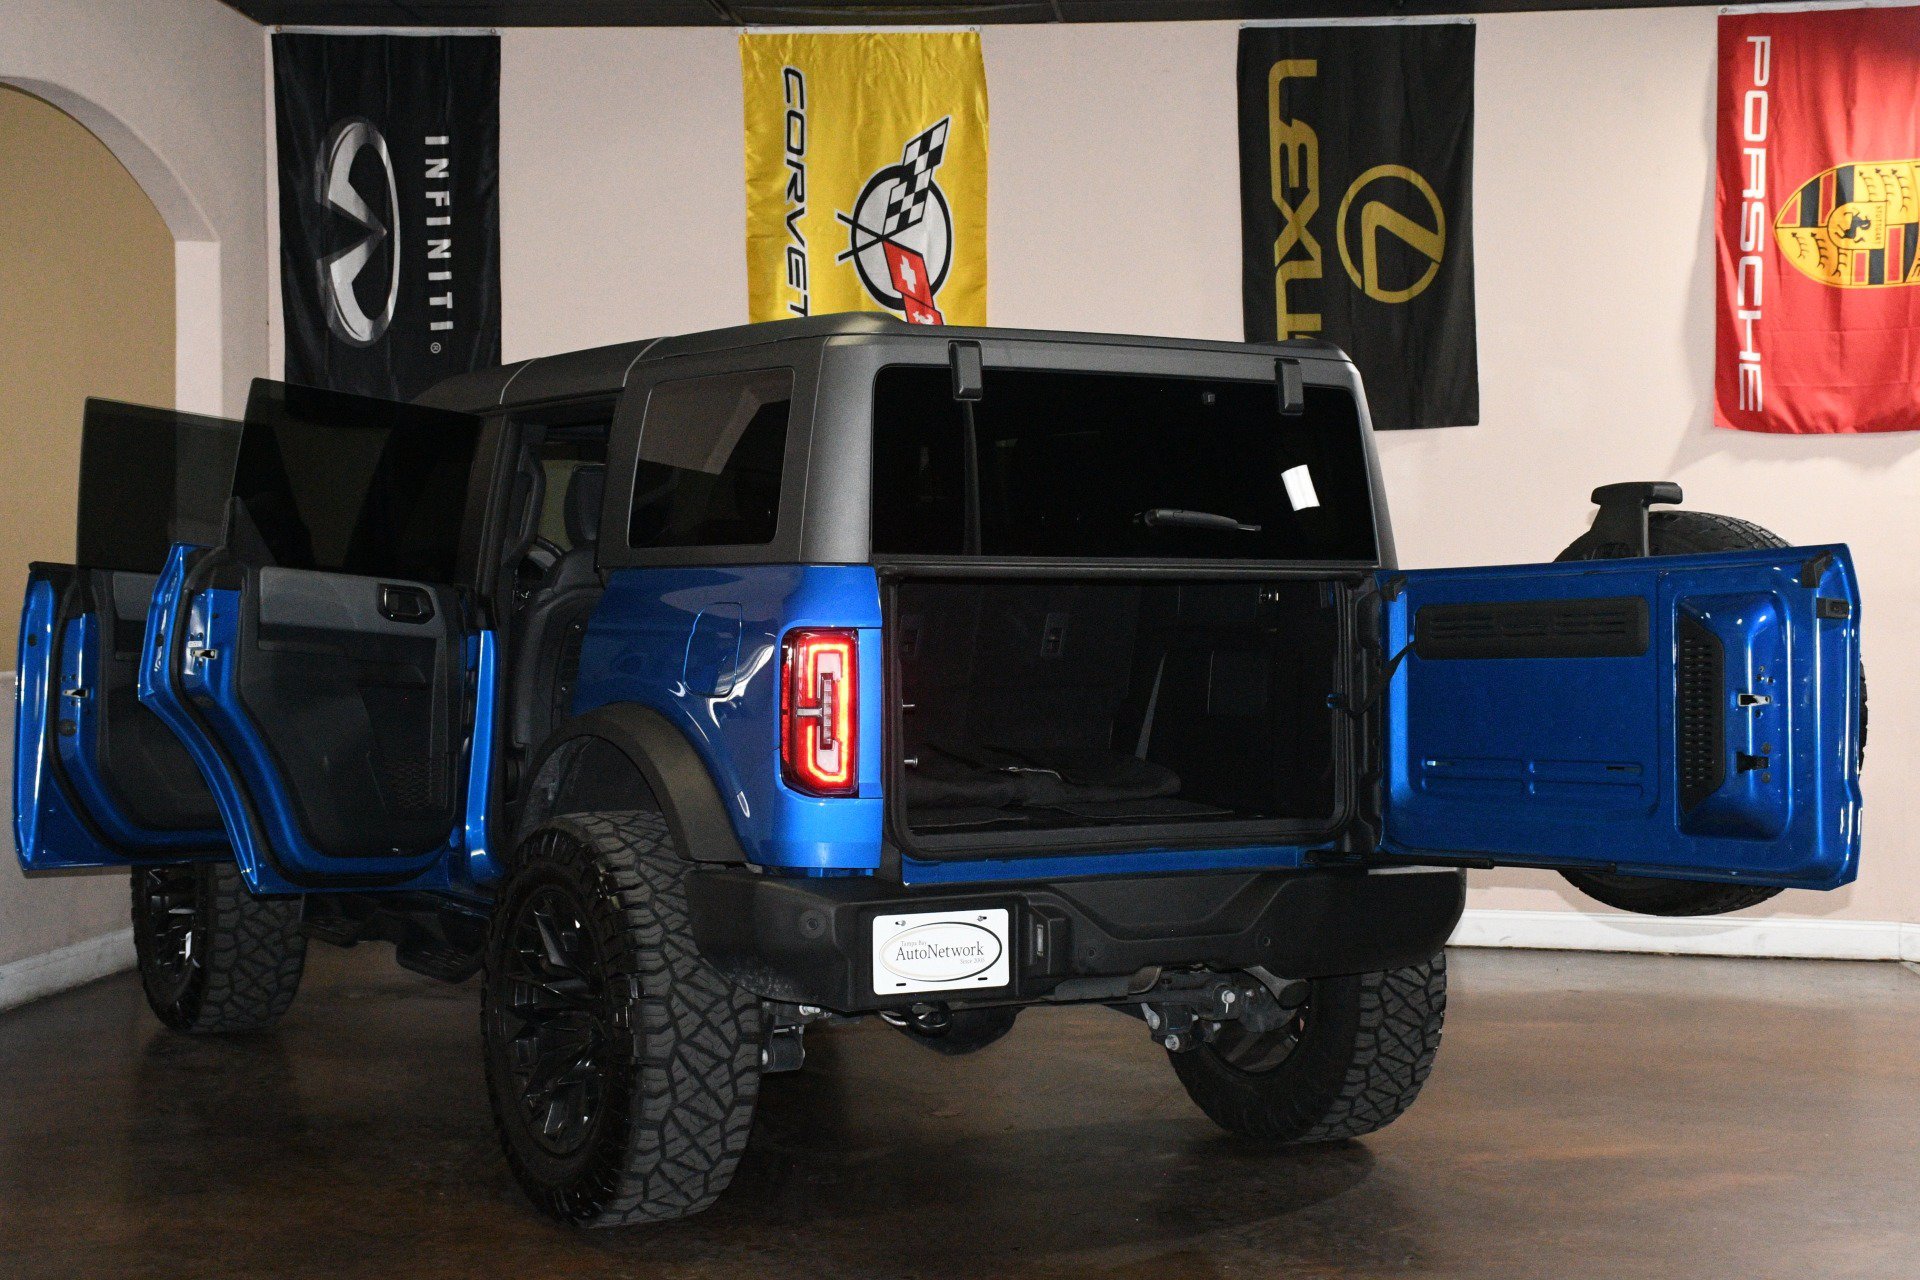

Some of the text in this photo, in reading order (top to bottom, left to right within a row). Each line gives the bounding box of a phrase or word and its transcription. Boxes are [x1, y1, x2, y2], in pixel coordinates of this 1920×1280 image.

[424, 135, 454, 331] INFINITI
[1268, 59, 1322, 342] LEXU
[1738, 35, 1771, 412] PORSCHE
[896, 941, 985, 961] AutoNetwork
